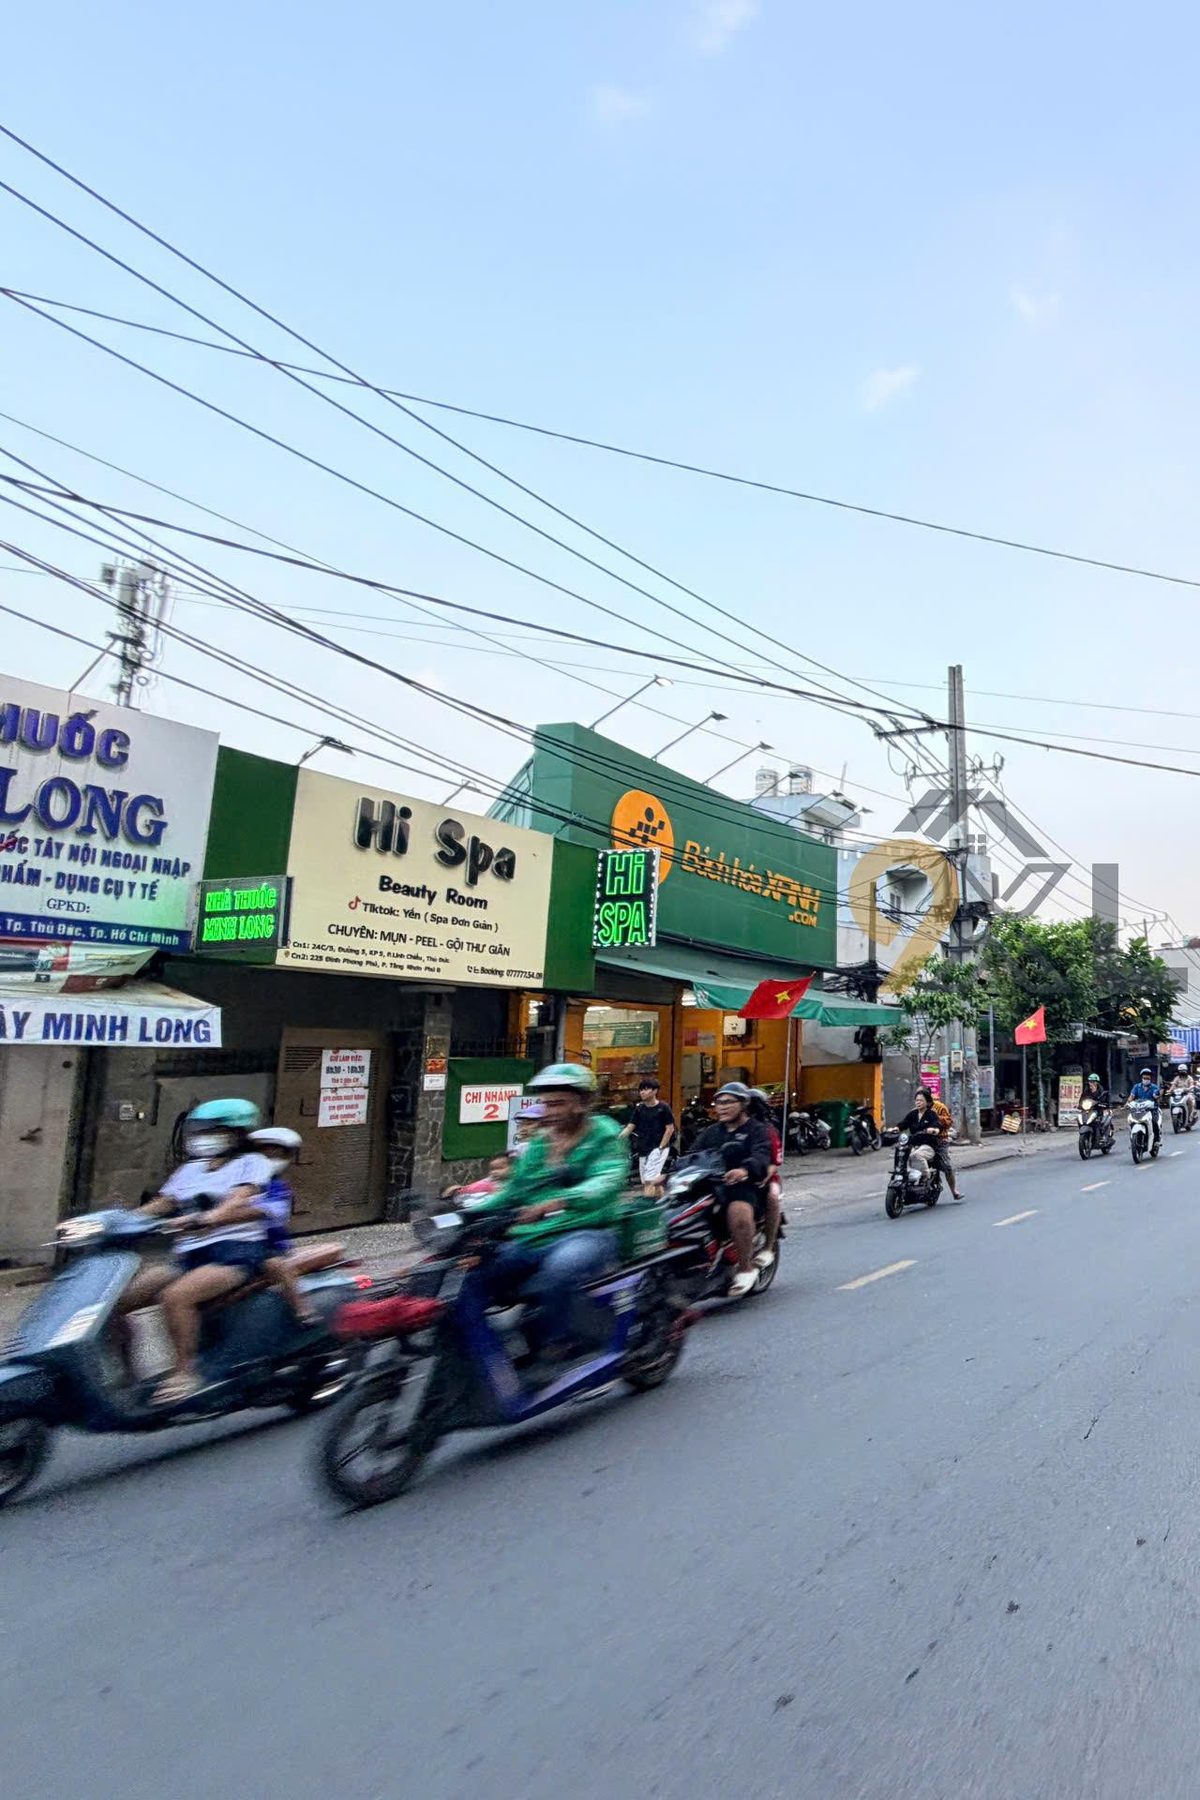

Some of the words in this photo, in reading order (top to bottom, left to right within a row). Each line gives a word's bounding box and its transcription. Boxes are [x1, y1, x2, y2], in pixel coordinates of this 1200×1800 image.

[0, 766, 168, 847] LONG
[354, 797, 412, 855] Hi
[434, 818, 516, 886] Spa
[34, 837, 64, 859] TÂY
[68, 843, 96, 867] NỘI
[101, 849, 147, 875] NGOẠI
[152, 857, 191, 880] NHẬP
[55, 871, 100, 894] DỤNG
[103, 878, 124, 901] CỤ
[128, 881, 137, 898] Y
[141, 879, 160, 901] TẾ
[606, 853, 645, 895] Hi
[46, 898, 91, 914] GPKD:
[205, 888, 232, 912] NHÀ
[378, 875, 437, 906] Beauty
[446, 888, 488, 910] Room
[6, 917, 26, 933] Tp.
[238, 914, 275, 940] LONG
[430, 914, 449, 926] Spa
[598, 902, 646, 944] SPA
[328, 924, 378, 940] CHUYÊN:
[380, 930, 407, 945] MỤN
[415, 934, 438, 948] PEEL
[42, 1012, 129, 1041] MINH
[139, 1017, 211, 1043] LONG
[465, 1092, 481, 1104] CHI
[483, 1104, 499, 1119] 2
